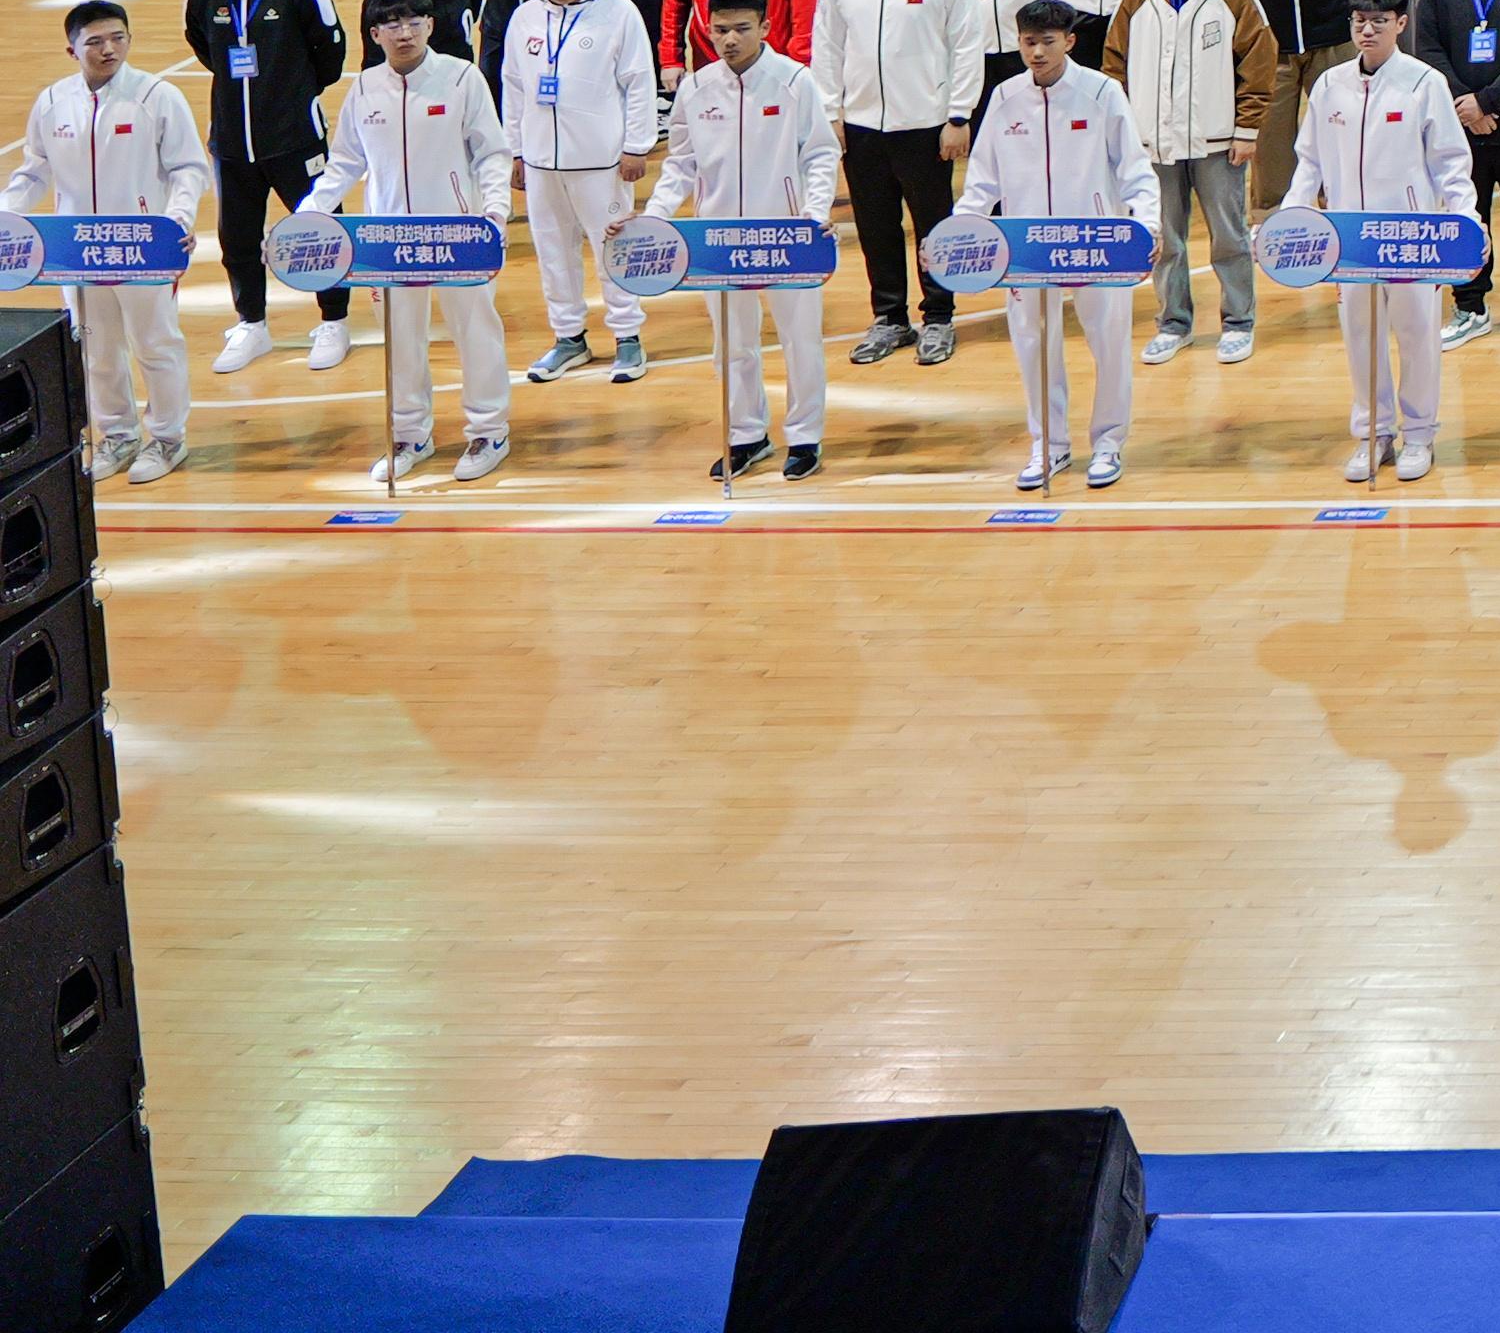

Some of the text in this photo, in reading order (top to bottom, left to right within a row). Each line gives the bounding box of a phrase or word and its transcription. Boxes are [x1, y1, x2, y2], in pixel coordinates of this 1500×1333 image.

[74, 223, 152, 243] 友好医院
[705, 227, 812, 245] 新疆油田公司
[1025, 226, 1132, 243] 兵团第十三师
[1360, 221, 1459, 240] 兵团第九师
[83, 246, 145, 266] 代表队
[394, 245, 455, 264] 代表队
[730, 249, 790, 267] 代表队
[1050, 249, 1110, 267] 代表队
[1377, 244, 1440, 264] 代表队
